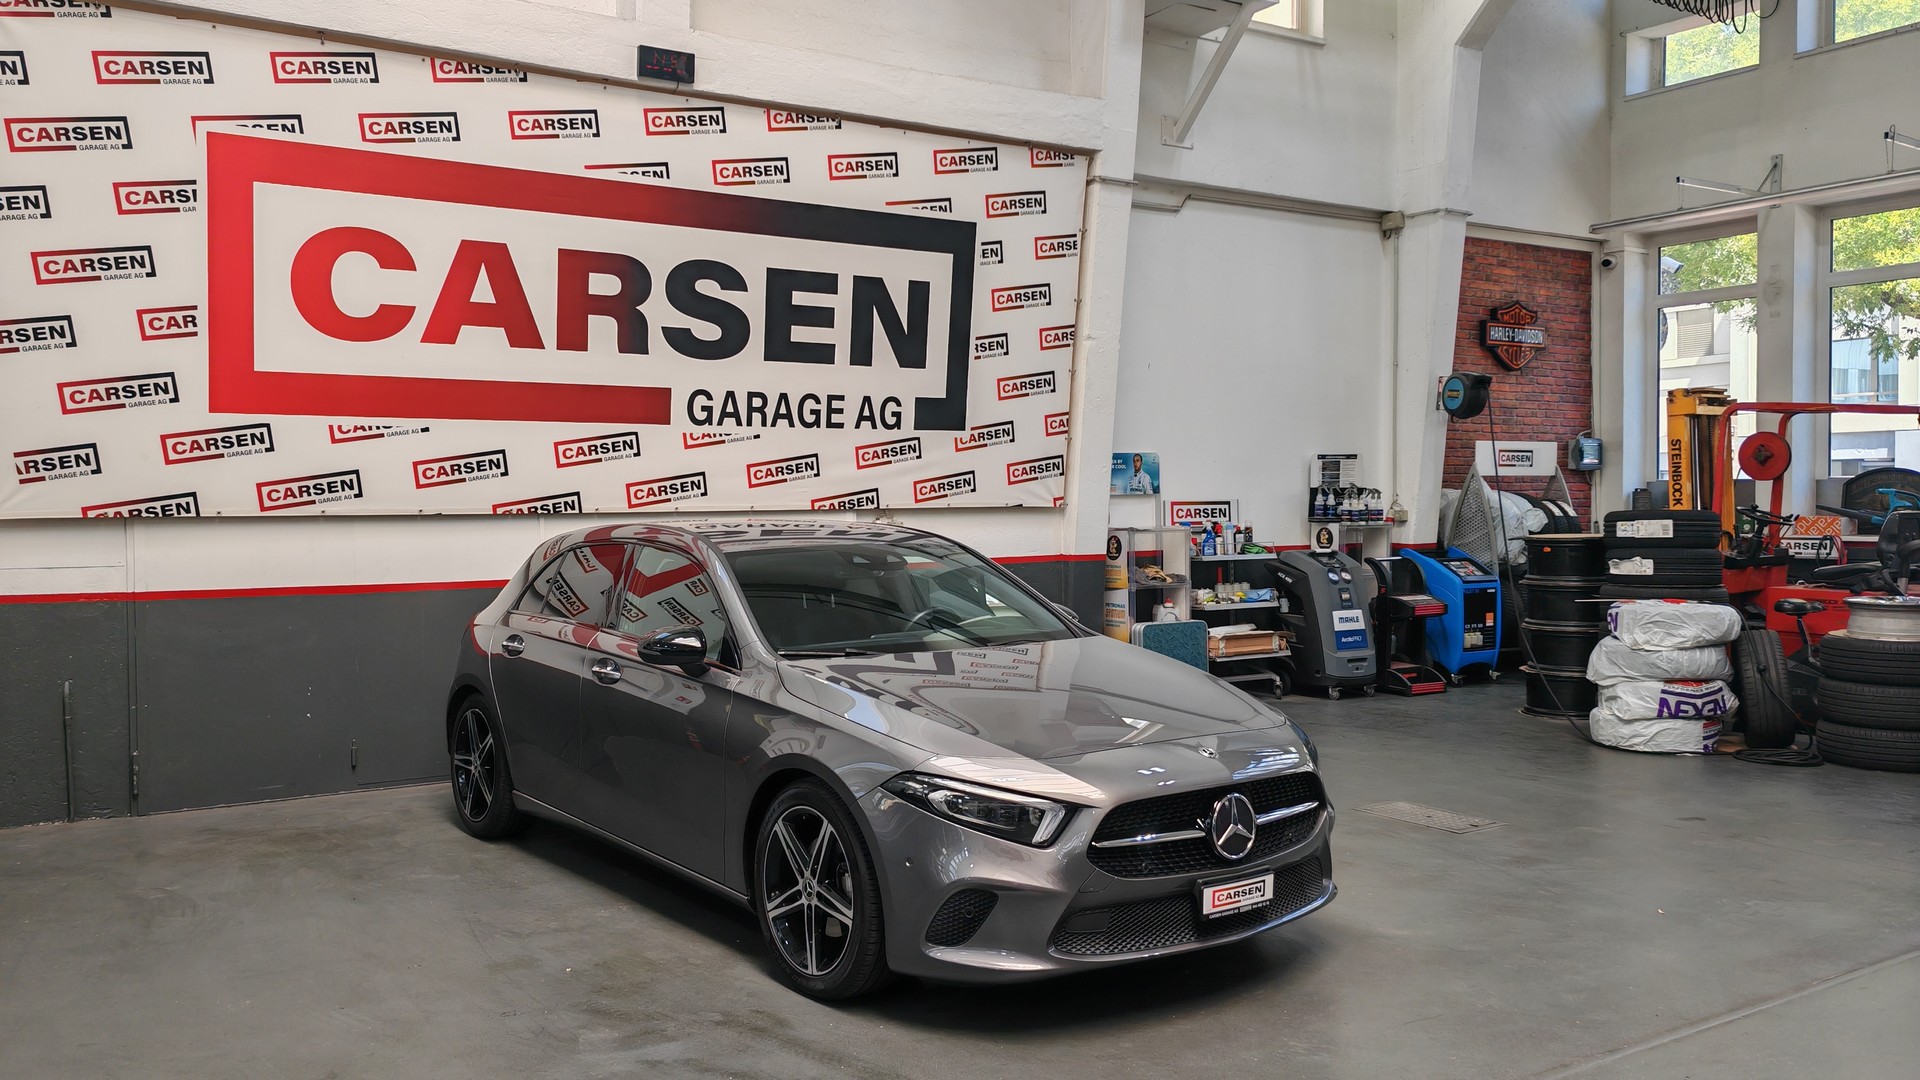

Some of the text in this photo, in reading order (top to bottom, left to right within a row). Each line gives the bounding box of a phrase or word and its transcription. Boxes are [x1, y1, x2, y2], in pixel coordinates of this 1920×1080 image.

[104, 60, 204, 76] CARSEN
[281, 61, 370, 75] CARSEN
[369, 120, 453, 135] CARSEN
[517, 118, 593, 131] CARSEN
[651, 115, 720, 128] CARSEN
[17, 125, 122, 143] CARSEN
[834, 160, 893, 173] CARSEN
[939, 155, 993, 167] CARSEN
[719, 165, 784, 179] CARSEN
[991, 198, 1042, 211] CARSEN
[43, 255, 146, 274] CARSEN
[104, 273, 132, 281] GARAGE
[290, 226, 930, 369] CARSEN
[996, 290, 1047, 305] CARSEN
[148, 315, 198, 332] CAR
[1503, 312, 1530, 324] MOTOR
[1490, 326, 1544, 344] HARLEY-DAVIDSON
[69, 382, 170, 404] CARSEN
[1002, 377, 1052, 393] CARSEN
[128, 400, 155, 408] GARAGE
[686, 389, 902, 431] GARAGE AG
[386, 430, 412, 438] GARAGE
[172, 432, 265, 455] CARSEN
[562, 440, 634, 459] CARSEN
[227, 450, 253, 458] GARAGE
[861, 444, 917, 462] CARSEN
[1501, 454, 1531, 462] CARSEN
[48, 472, 75, 481] GARAGE
[421, 458, 501, 480] CARSEN
[753, 462, 815, 480] CARSEN
[1012, 462, 1060, 479] CARSEN
[1670, 438, 1683, 508] STEINBOCK
[266, 479, 354, 502] CARSEN
[633, 480, 701, 500] CARSEN
[919, 478, 972, 495] CARSEN
[318, 496, 342, 504] GARAGE
[1176, 508, 1227, 518] CARSEN
[1338, 616, 1360, 624] MAHLE
[1217, 885, 1262, 902] CARSEN
